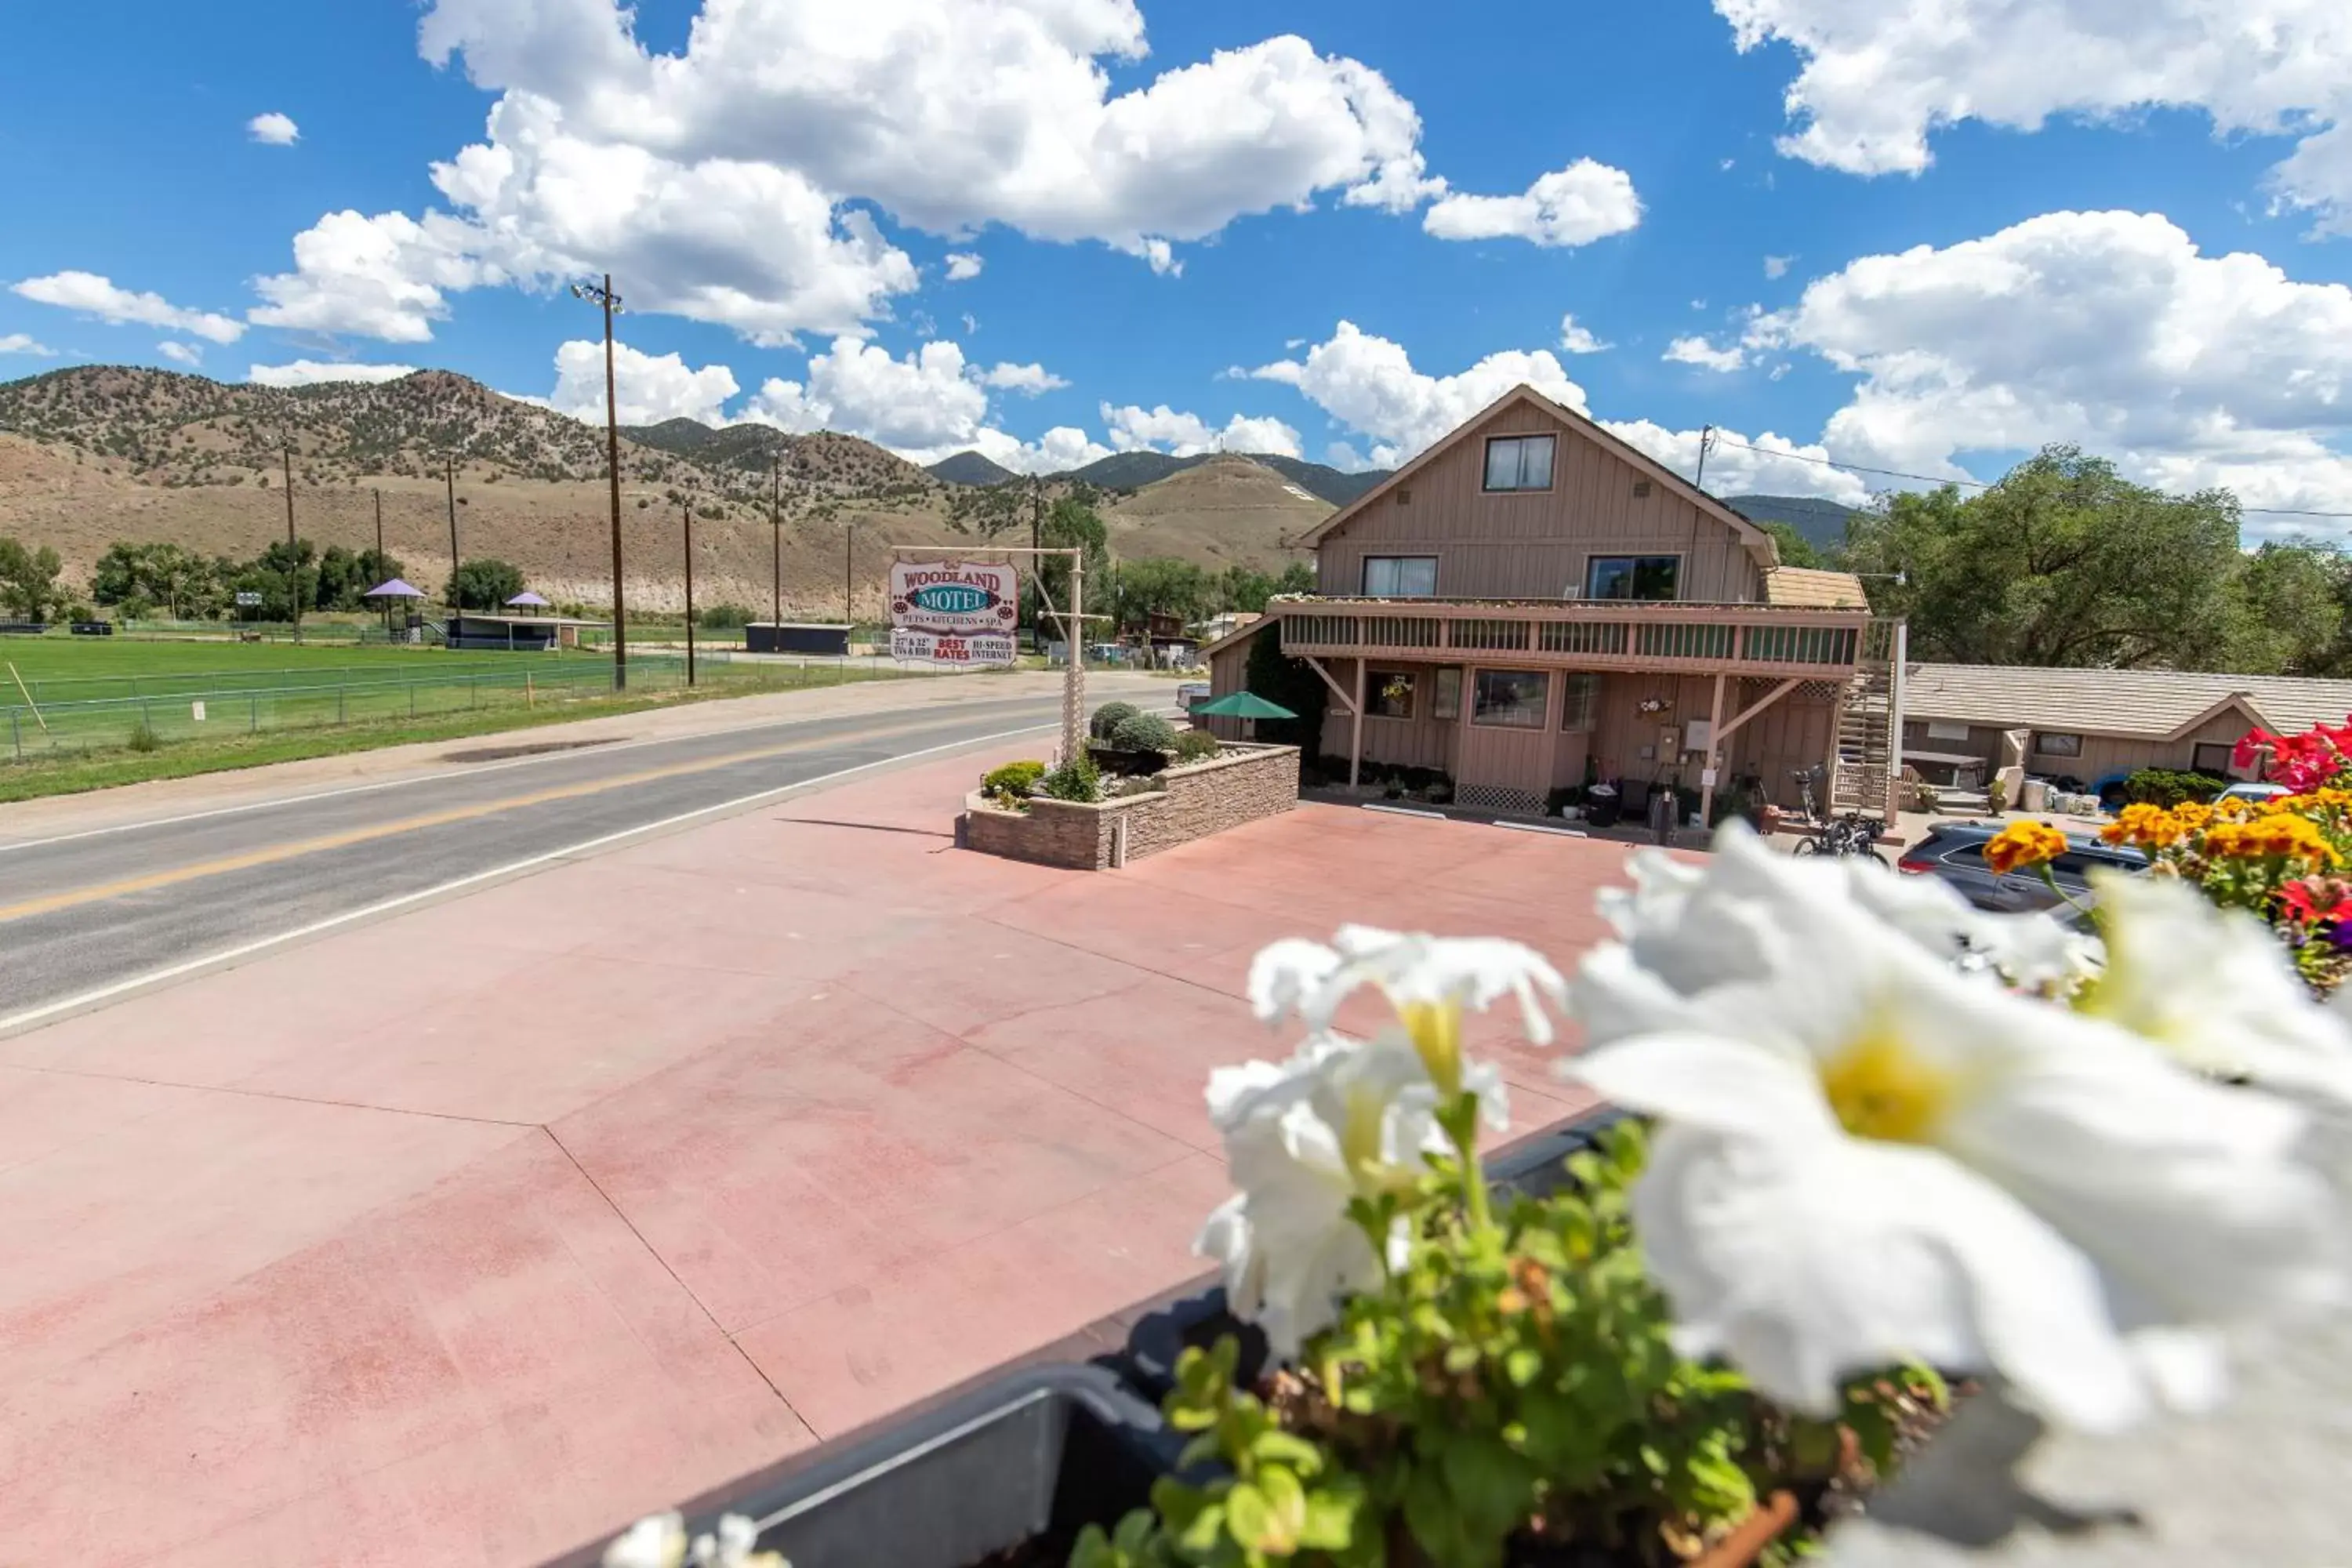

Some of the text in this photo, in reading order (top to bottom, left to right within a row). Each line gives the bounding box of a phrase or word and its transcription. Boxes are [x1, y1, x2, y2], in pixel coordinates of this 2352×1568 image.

[904, 572, 1000, 591] WOODLAND
[920, 590, 980, 610] MOTEL
[902, 615, 924, 623] PETS
[985, 618, 1003, 626] SPA
[938, 639, 967, 649] BEST
[973, 641, 1012, 650] HI-SPEED
[934, 649, 970, 660] RATES
[972, 651, 1011, 659] INTERNET
